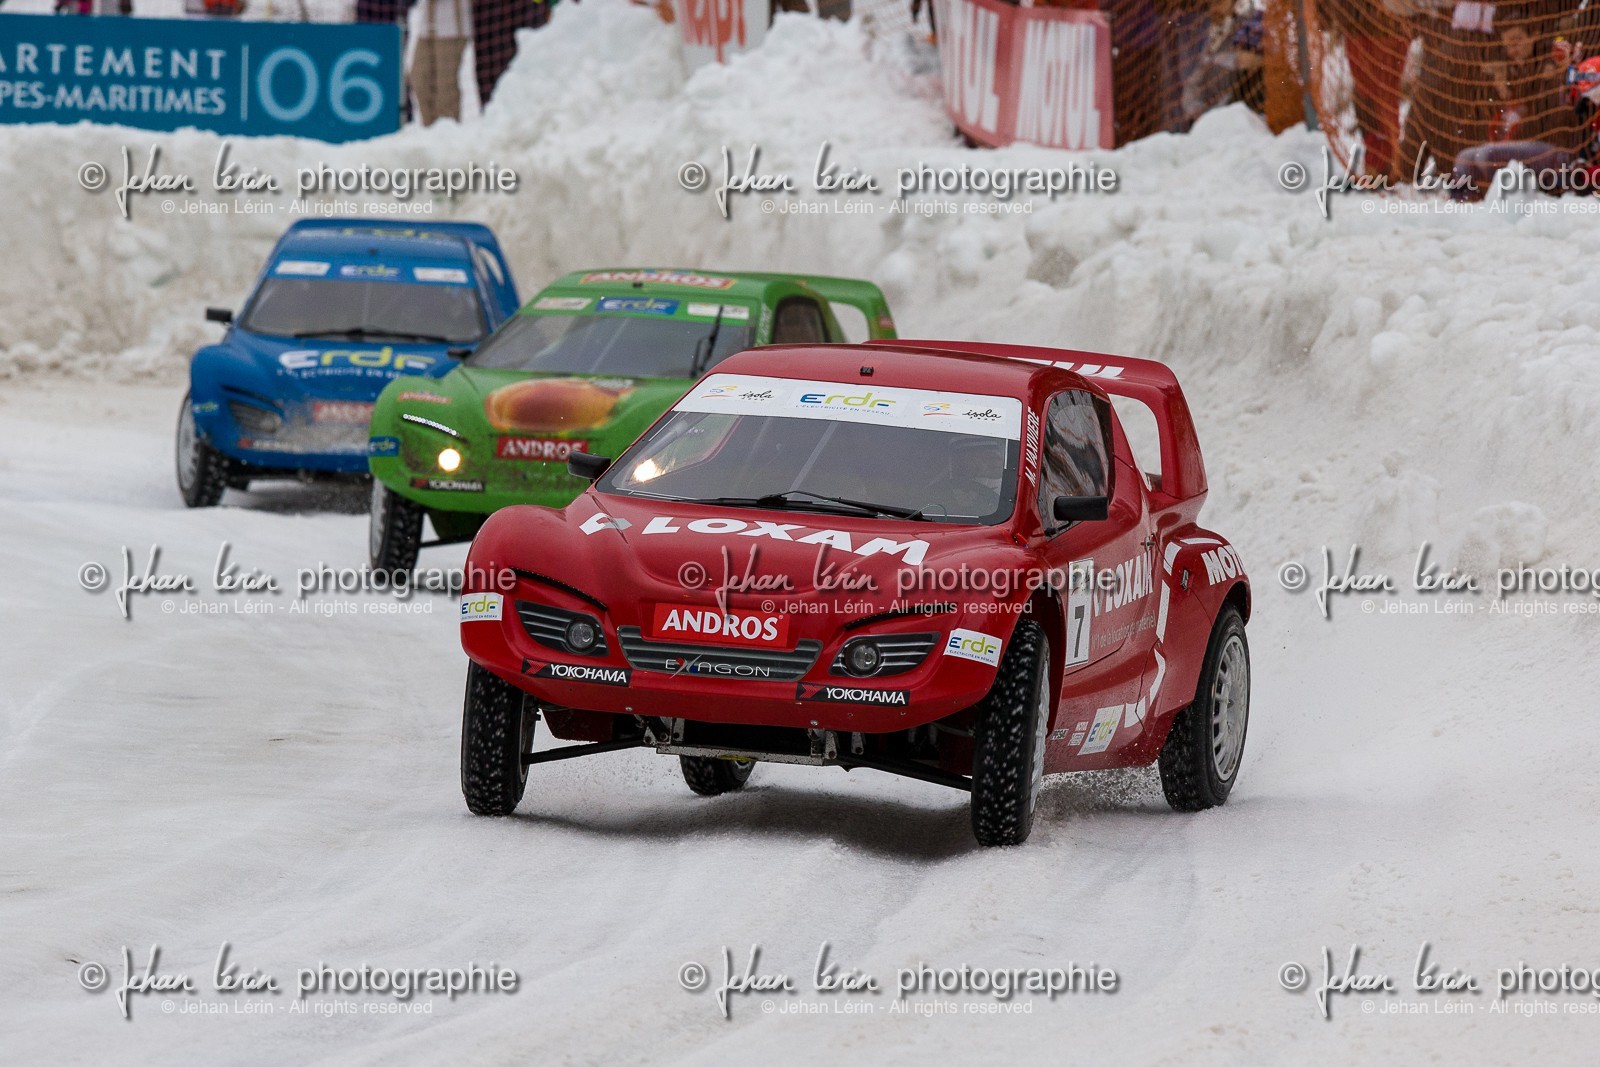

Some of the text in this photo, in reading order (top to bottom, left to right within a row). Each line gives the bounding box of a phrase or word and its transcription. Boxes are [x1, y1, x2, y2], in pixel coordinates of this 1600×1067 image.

[256, 47, 385, 124] 06
[642, 516, 931, 566] LOXAM
[1105, 552, 1154, 613] LOXAM
[1201, 544, 1248, 586] MOT
[661, 609, 779, 641] ANDROS
[1073, 604, 1086, 659] 7
[550, 663, 627, 683] YOKOHAMA
[665, 654, 771, 679] EXAGON
[826, 686, 907, 705] YOKOHAMA
